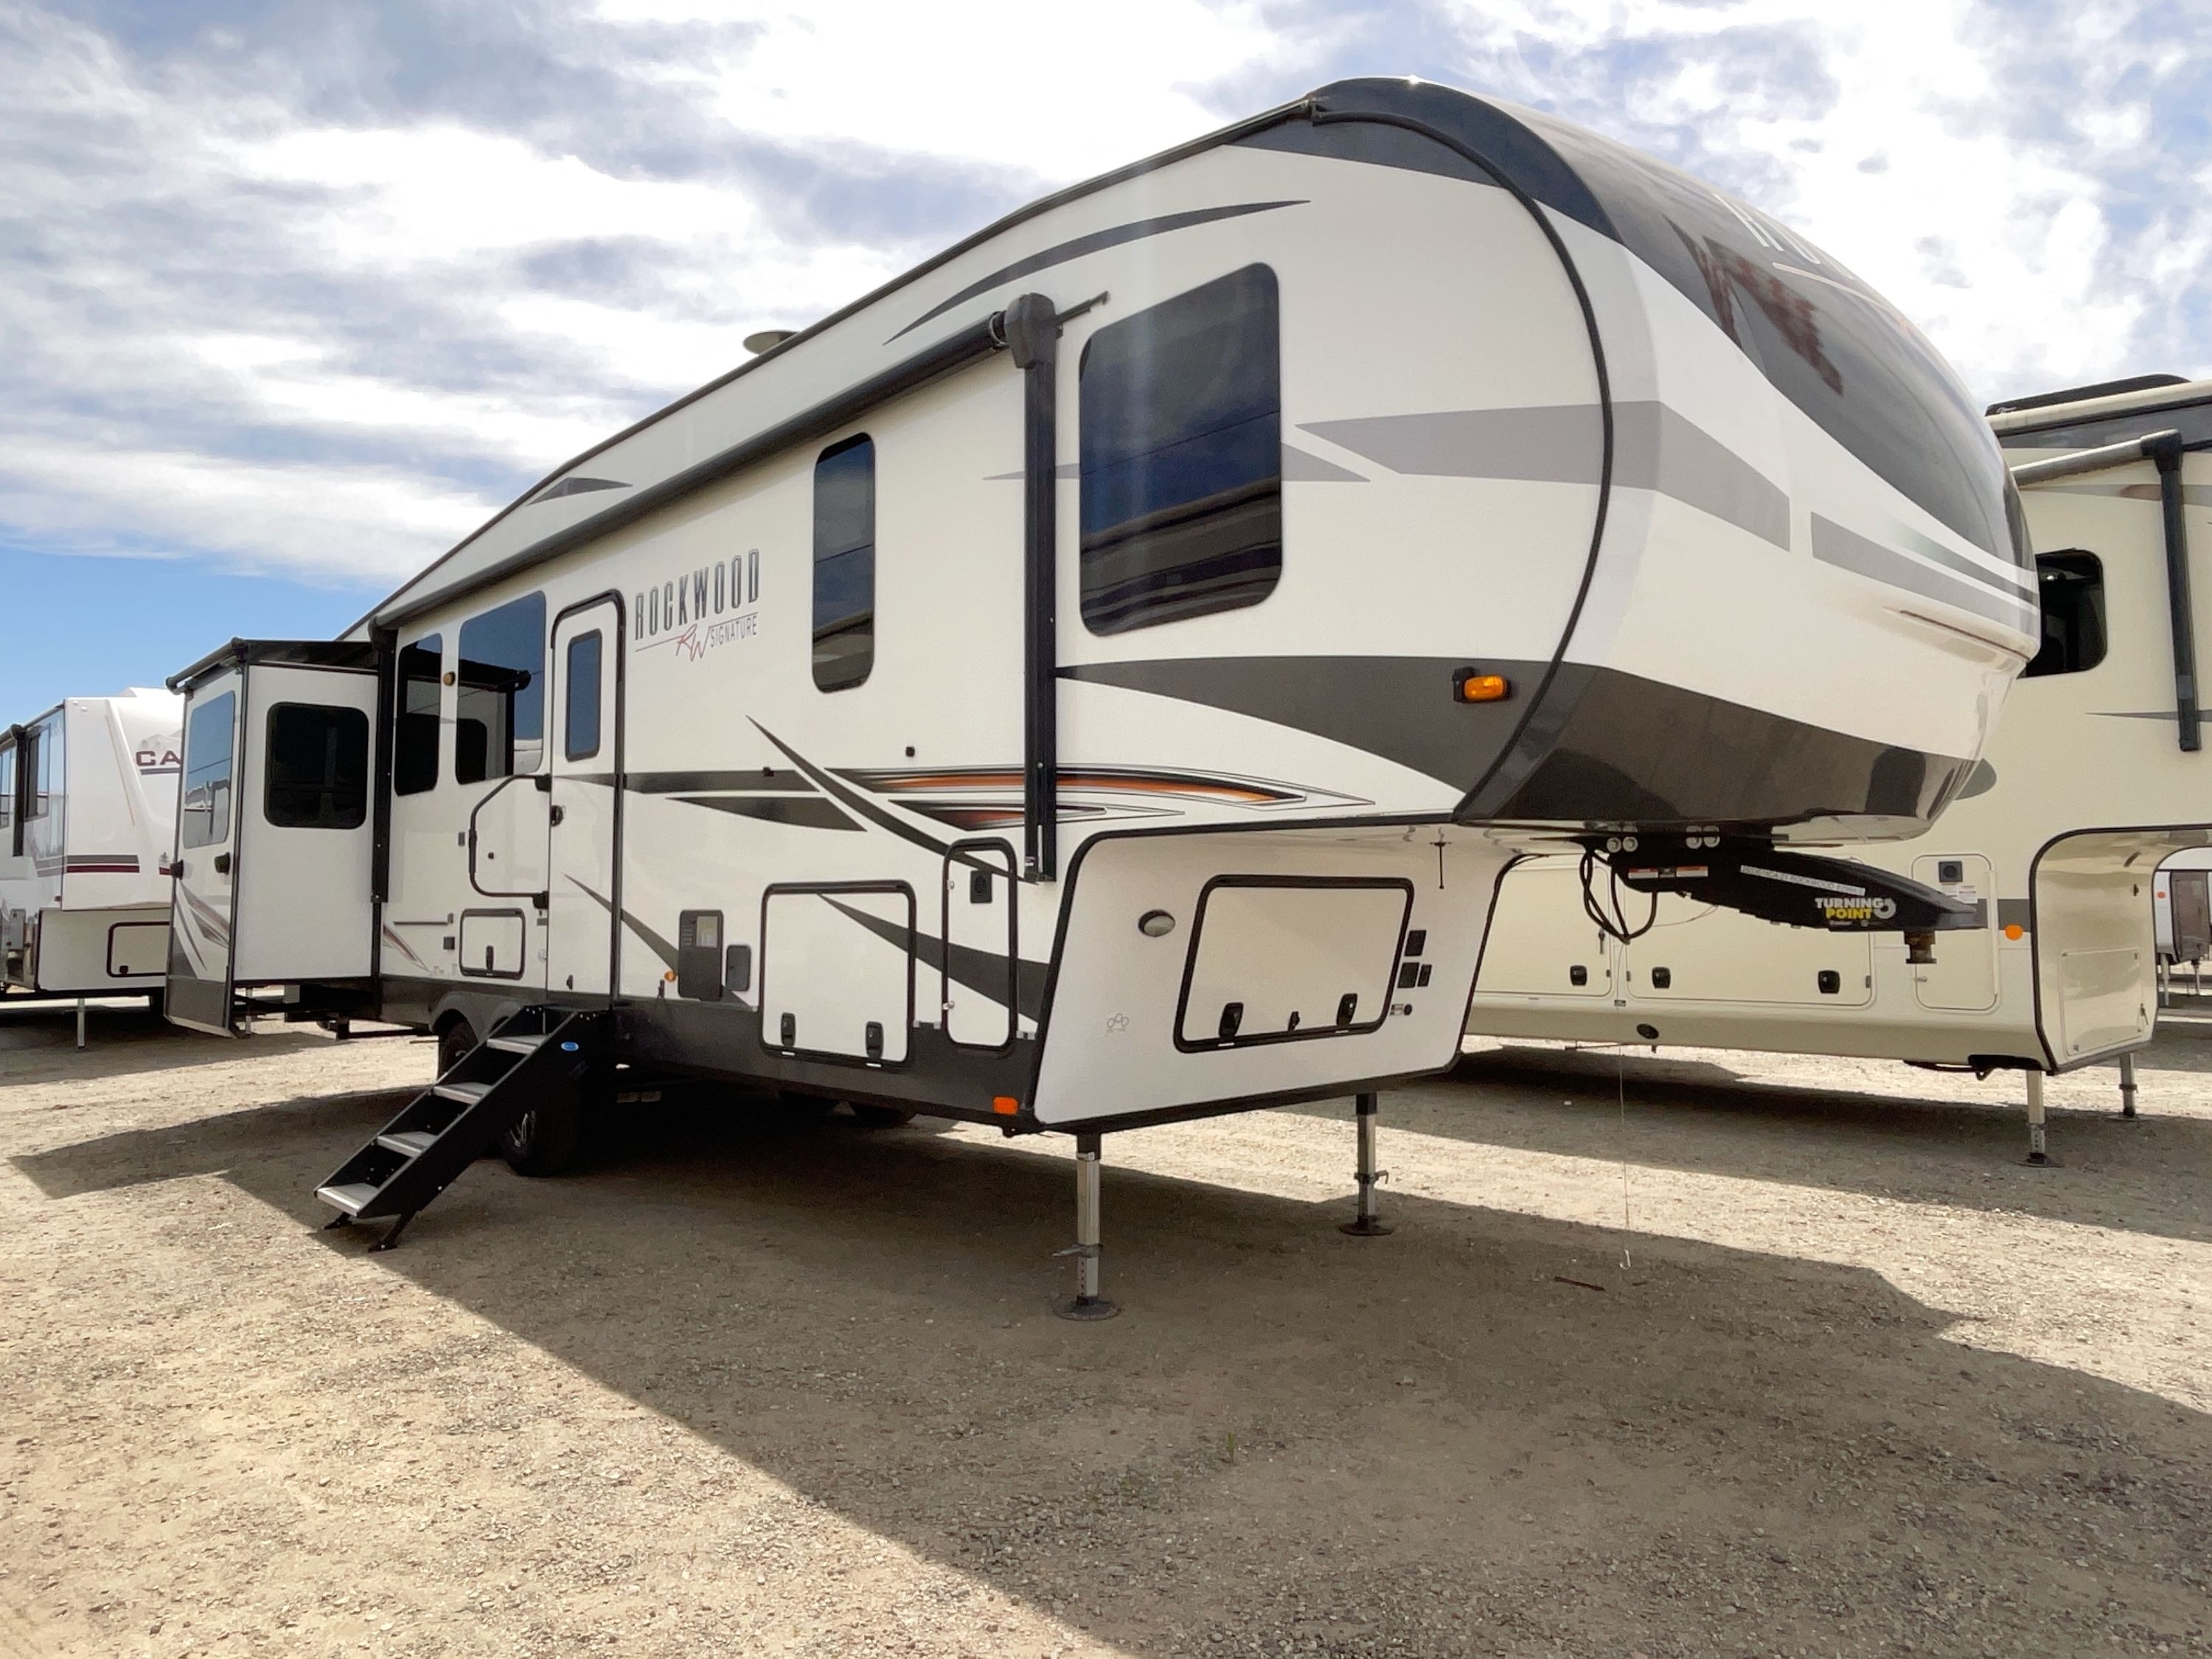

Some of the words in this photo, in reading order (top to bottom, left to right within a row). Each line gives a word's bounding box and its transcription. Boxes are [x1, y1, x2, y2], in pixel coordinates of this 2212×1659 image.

[635, 549, 759, 641] ROCKWOOD
[710, 615, 758, 648] SIGNATURE
[1815, 897, 1885, 909] TURNING
[1826, 908, 1872, 919] POINT
